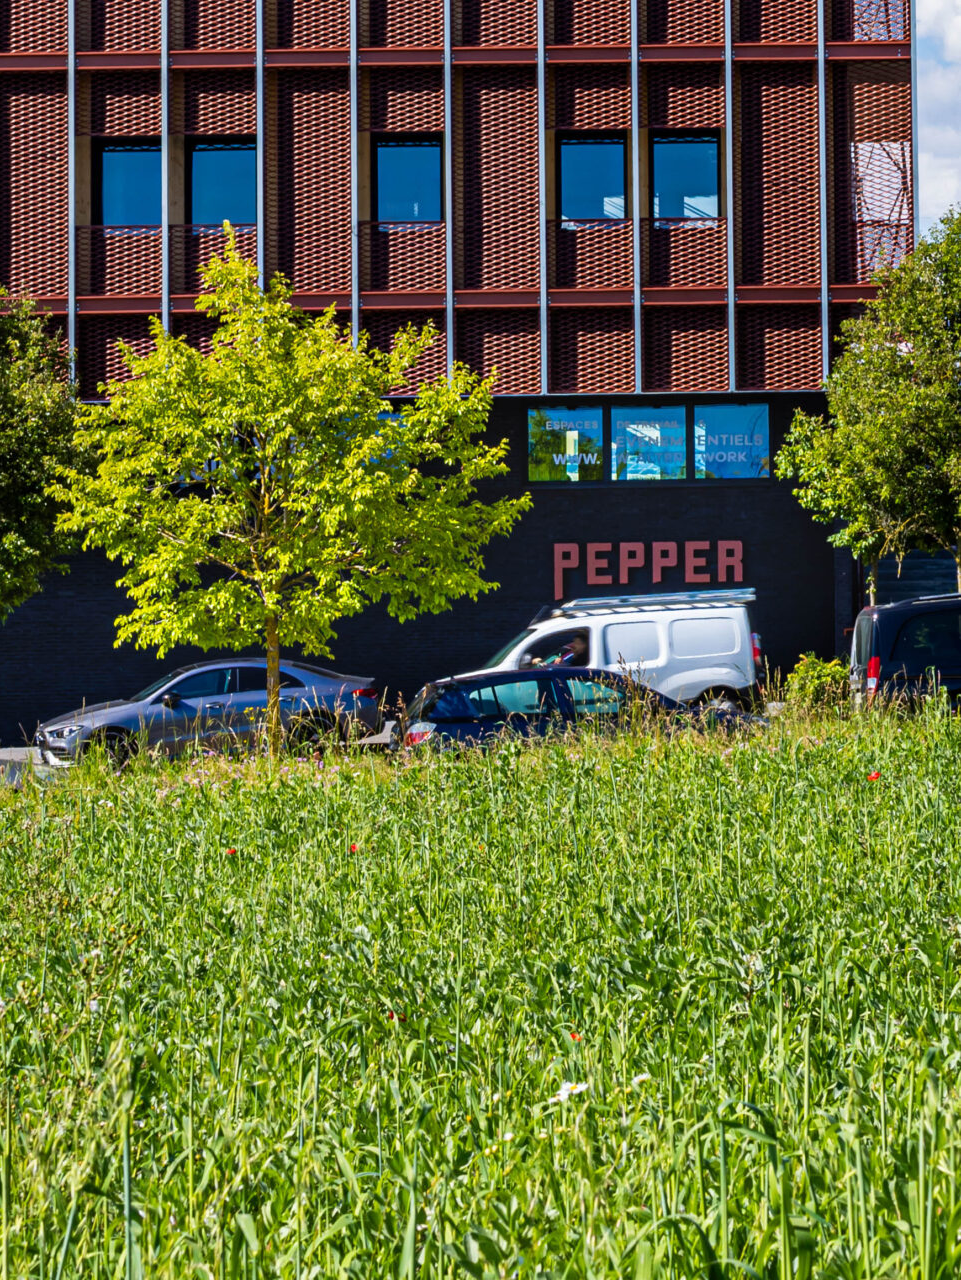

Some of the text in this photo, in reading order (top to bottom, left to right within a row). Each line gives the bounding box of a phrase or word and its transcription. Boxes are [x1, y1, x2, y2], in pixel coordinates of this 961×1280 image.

[545, 420, 599, 430] ESPACES
[697, 434, 764, 446] ENTIELS
[553, 540, 744, 601] PEPPER
